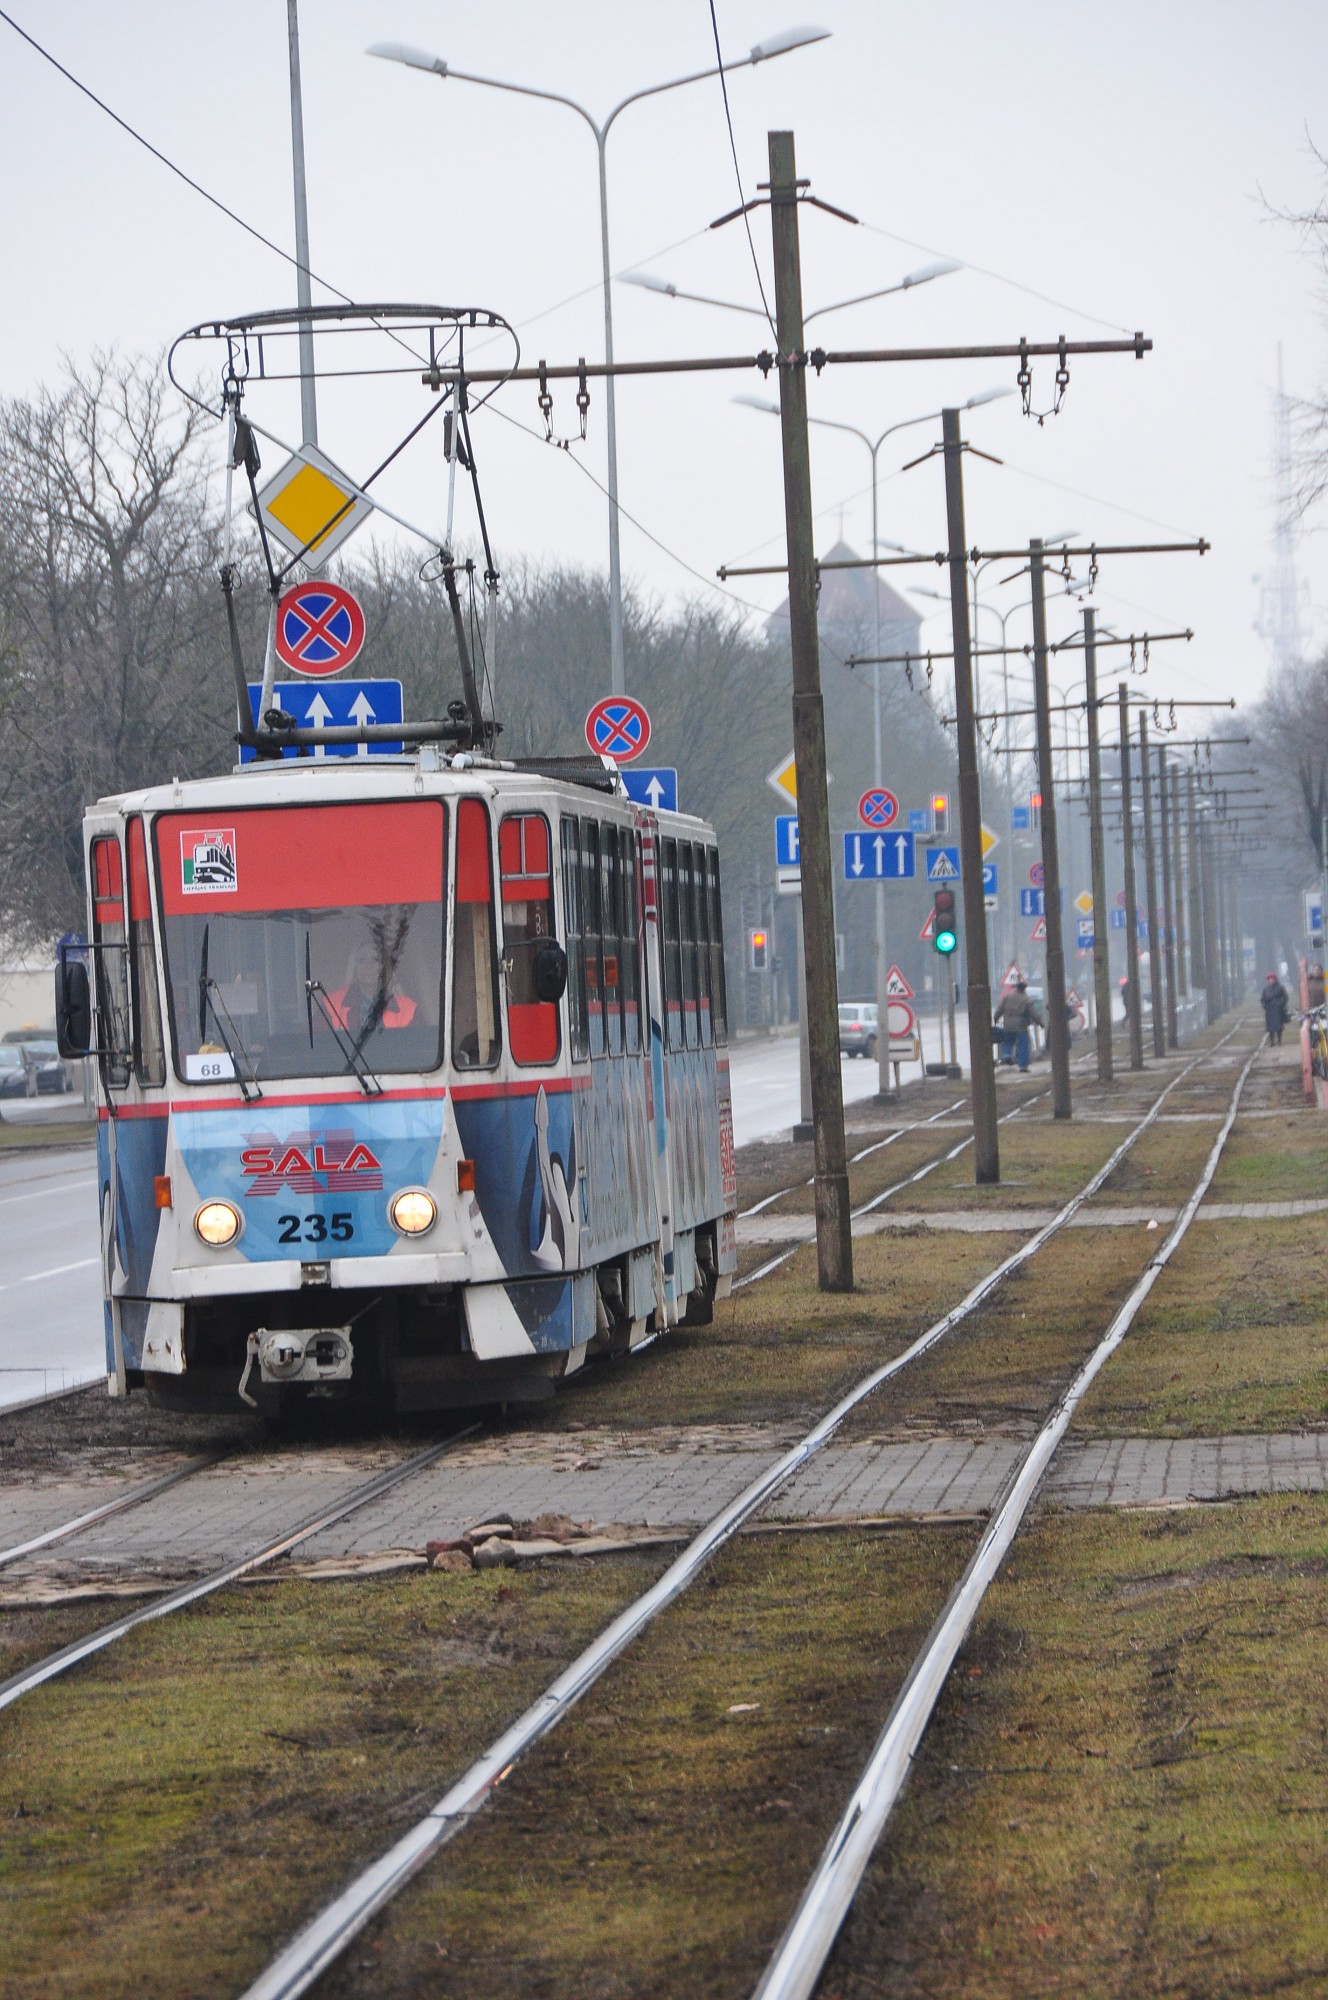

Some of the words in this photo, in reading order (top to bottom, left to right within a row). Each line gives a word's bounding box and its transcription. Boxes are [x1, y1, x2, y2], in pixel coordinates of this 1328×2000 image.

[201, 1064, 221, 1077] 68
[240, 1142, 383, 1177] SALA
[277, 1212, 354, 1244] 235
